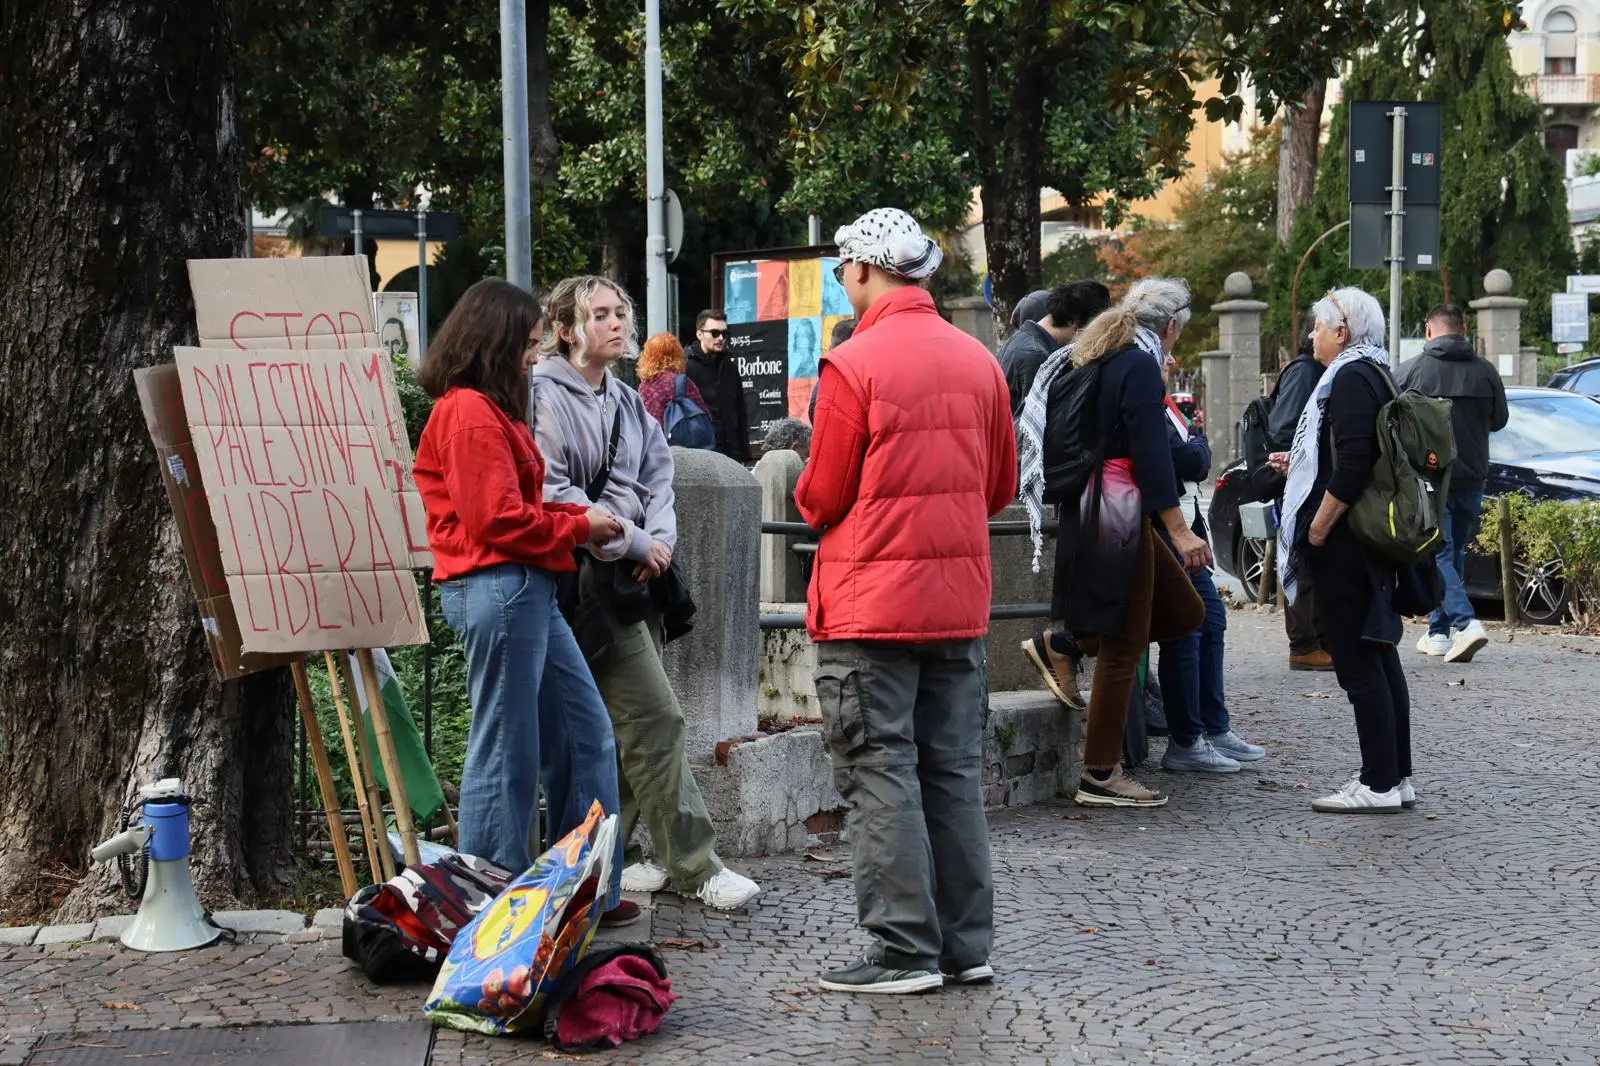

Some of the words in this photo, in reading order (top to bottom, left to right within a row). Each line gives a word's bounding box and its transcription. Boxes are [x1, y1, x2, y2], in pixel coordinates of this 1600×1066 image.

[192, 361, 388, 489] PALESTINA
[737, 355, 782, 376] Borbone
[223, 487, 414, 636] LIBERA
